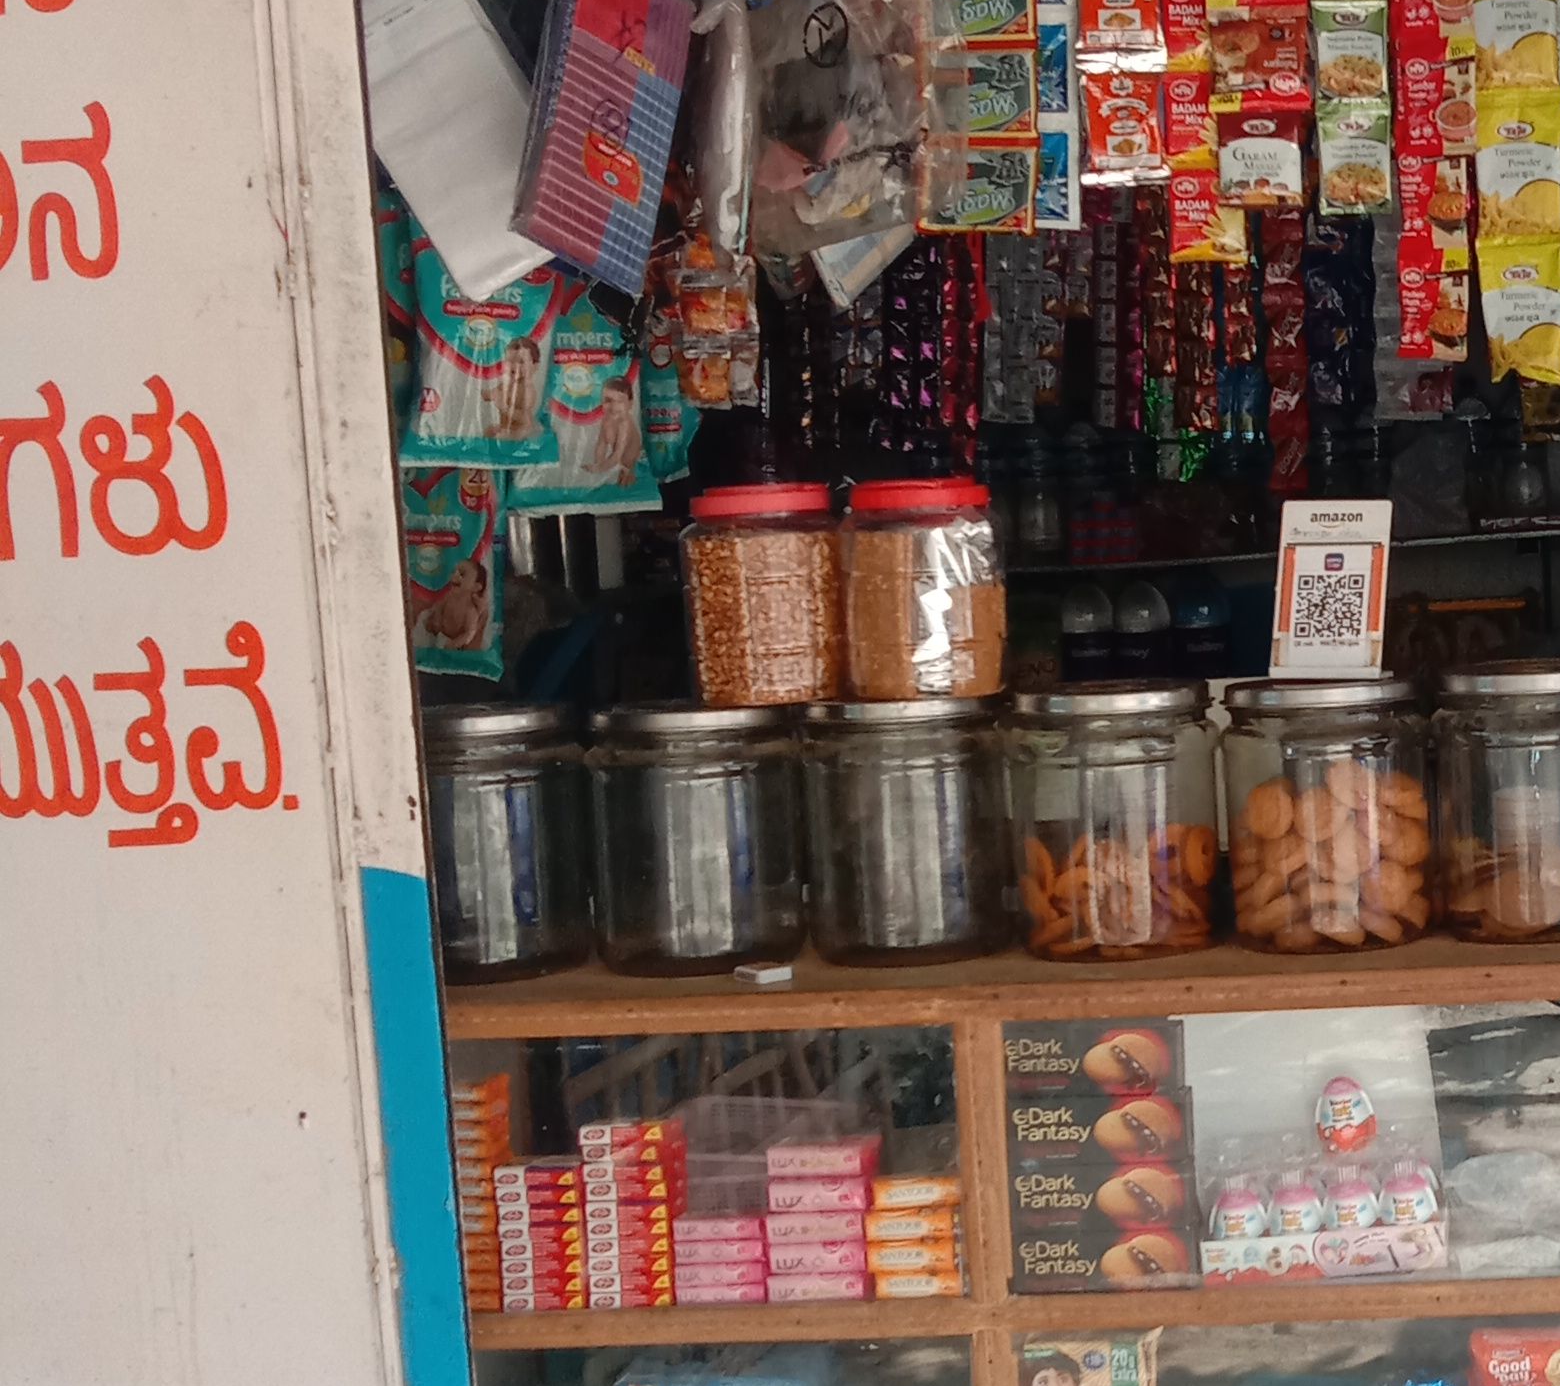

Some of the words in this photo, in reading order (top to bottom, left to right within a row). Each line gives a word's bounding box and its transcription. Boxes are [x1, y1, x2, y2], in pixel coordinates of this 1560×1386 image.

[1168, 4, 1203, 14] BADAM
[1171, 103, 1207, 114] BADAM
[1174, 200, 1210, 211] BADAM
[1310, 512, 1363, 523] amazon
[1019, 1038, 1063, 1056] Dark
[1007, 1056, 1081, 1074] Fantasy
[1029, 1107, 1074, 1125] Dark
[1017, 1124, 1091, 1144] Fantasy
[1032, 1174, 1076, 1192] Dark
[1019, 1191, 1094, 1210] Fantasy
[1036, 1241, 1080, 1259] Dark
[1024, 1258, 1097, 1277] Fantasy
[1489, 1356, 1531, 1373] Good
[1112, 1369, 1137, 1381] Extra
